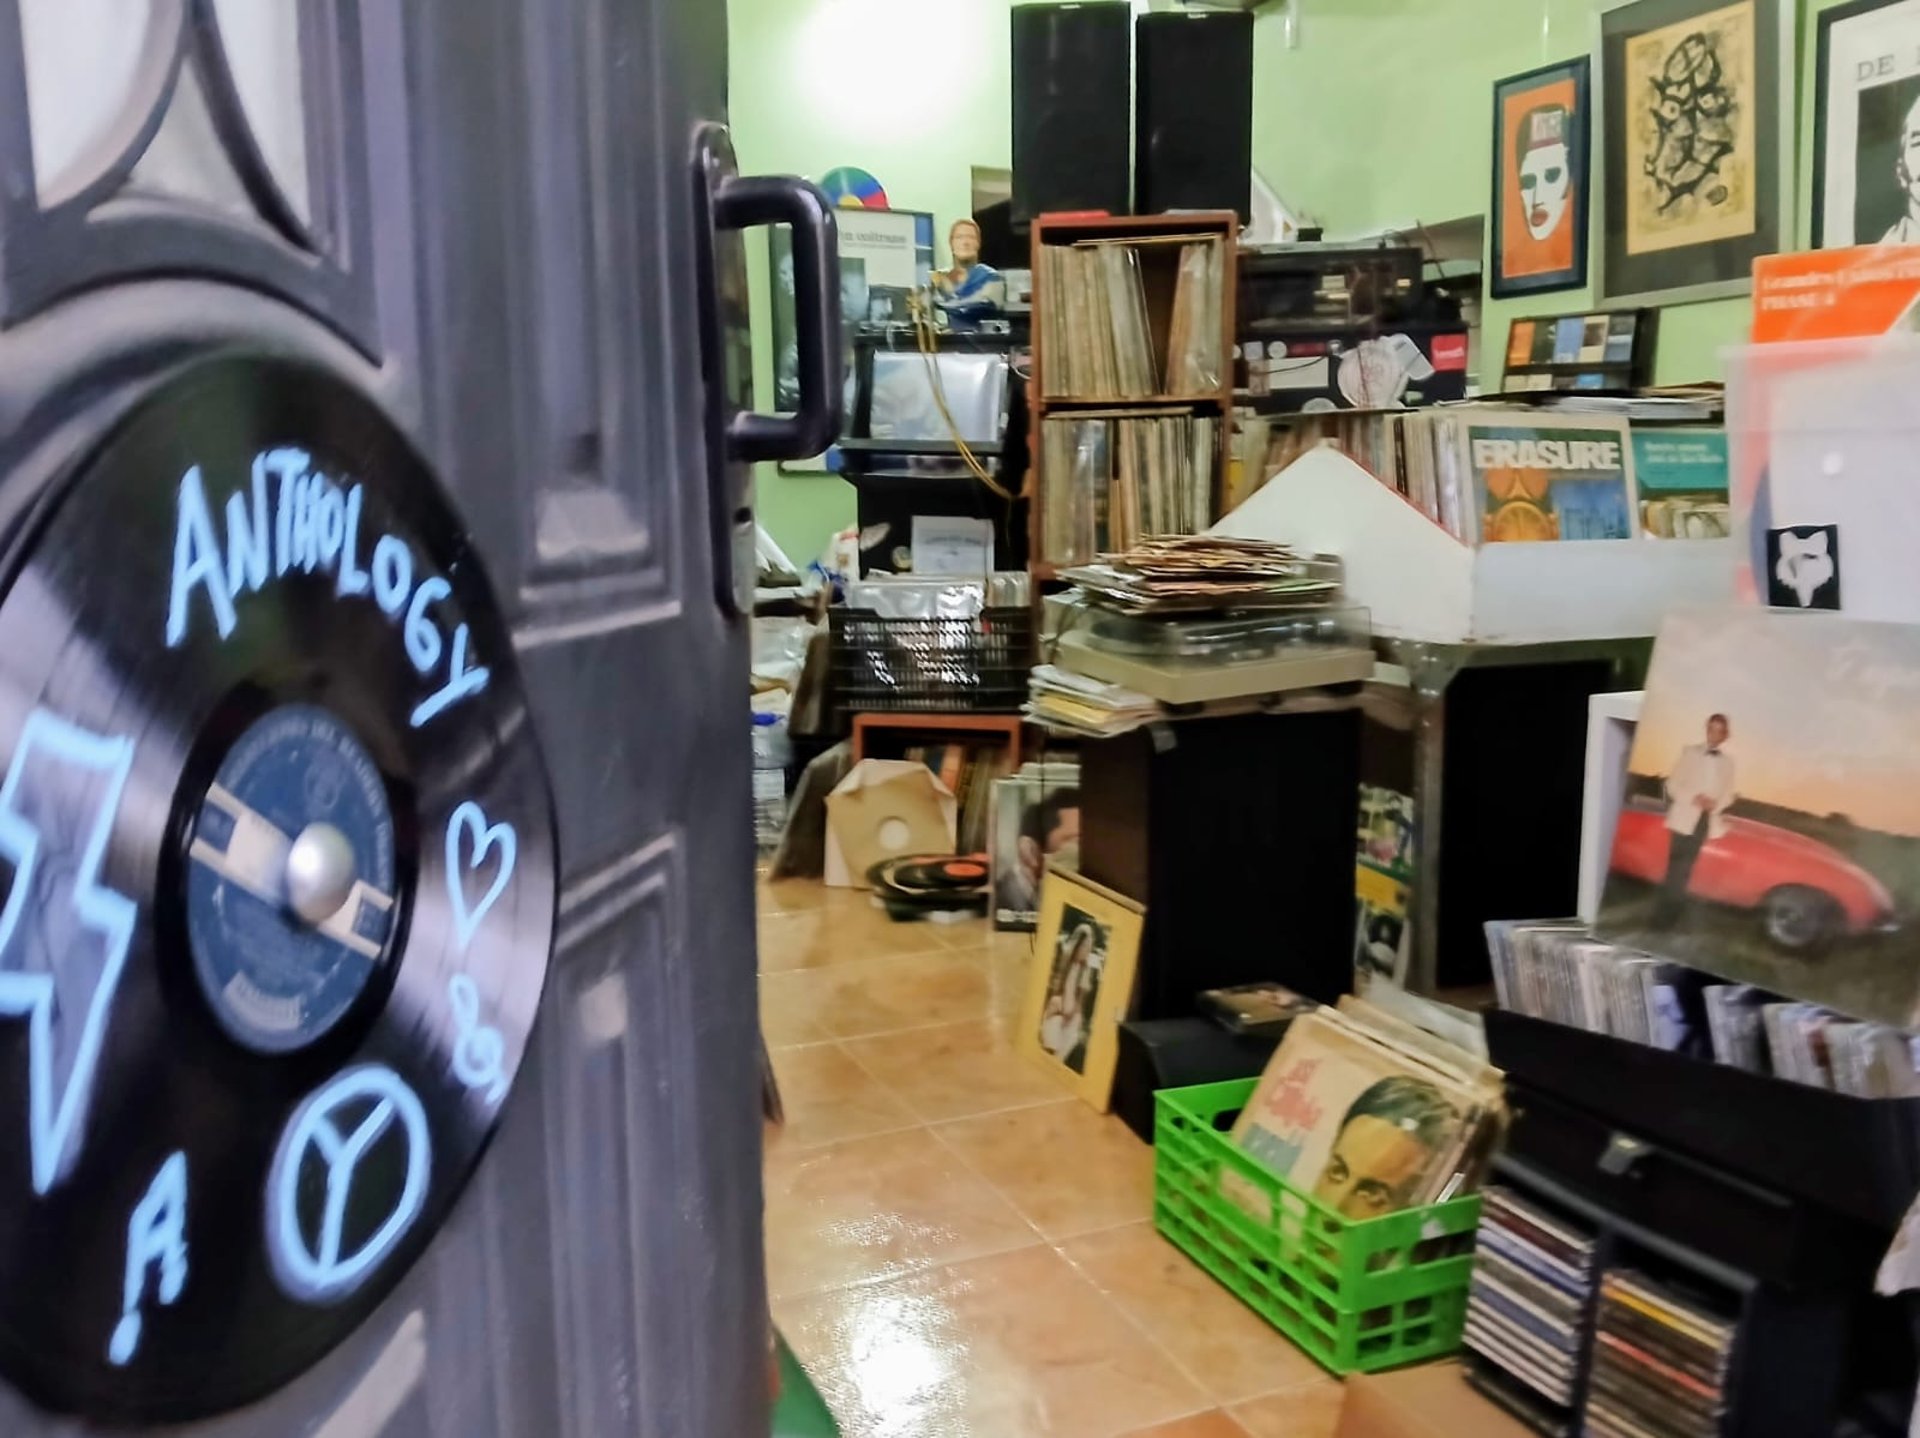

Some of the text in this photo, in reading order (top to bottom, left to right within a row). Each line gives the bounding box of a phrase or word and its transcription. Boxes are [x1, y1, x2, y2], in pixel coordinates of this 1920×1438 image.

[1857, 54, 1895, 82] DE
[1472, 439, 1621, 470] ERASURE
[165, 446, 489, 727] ANTHOLOGY
